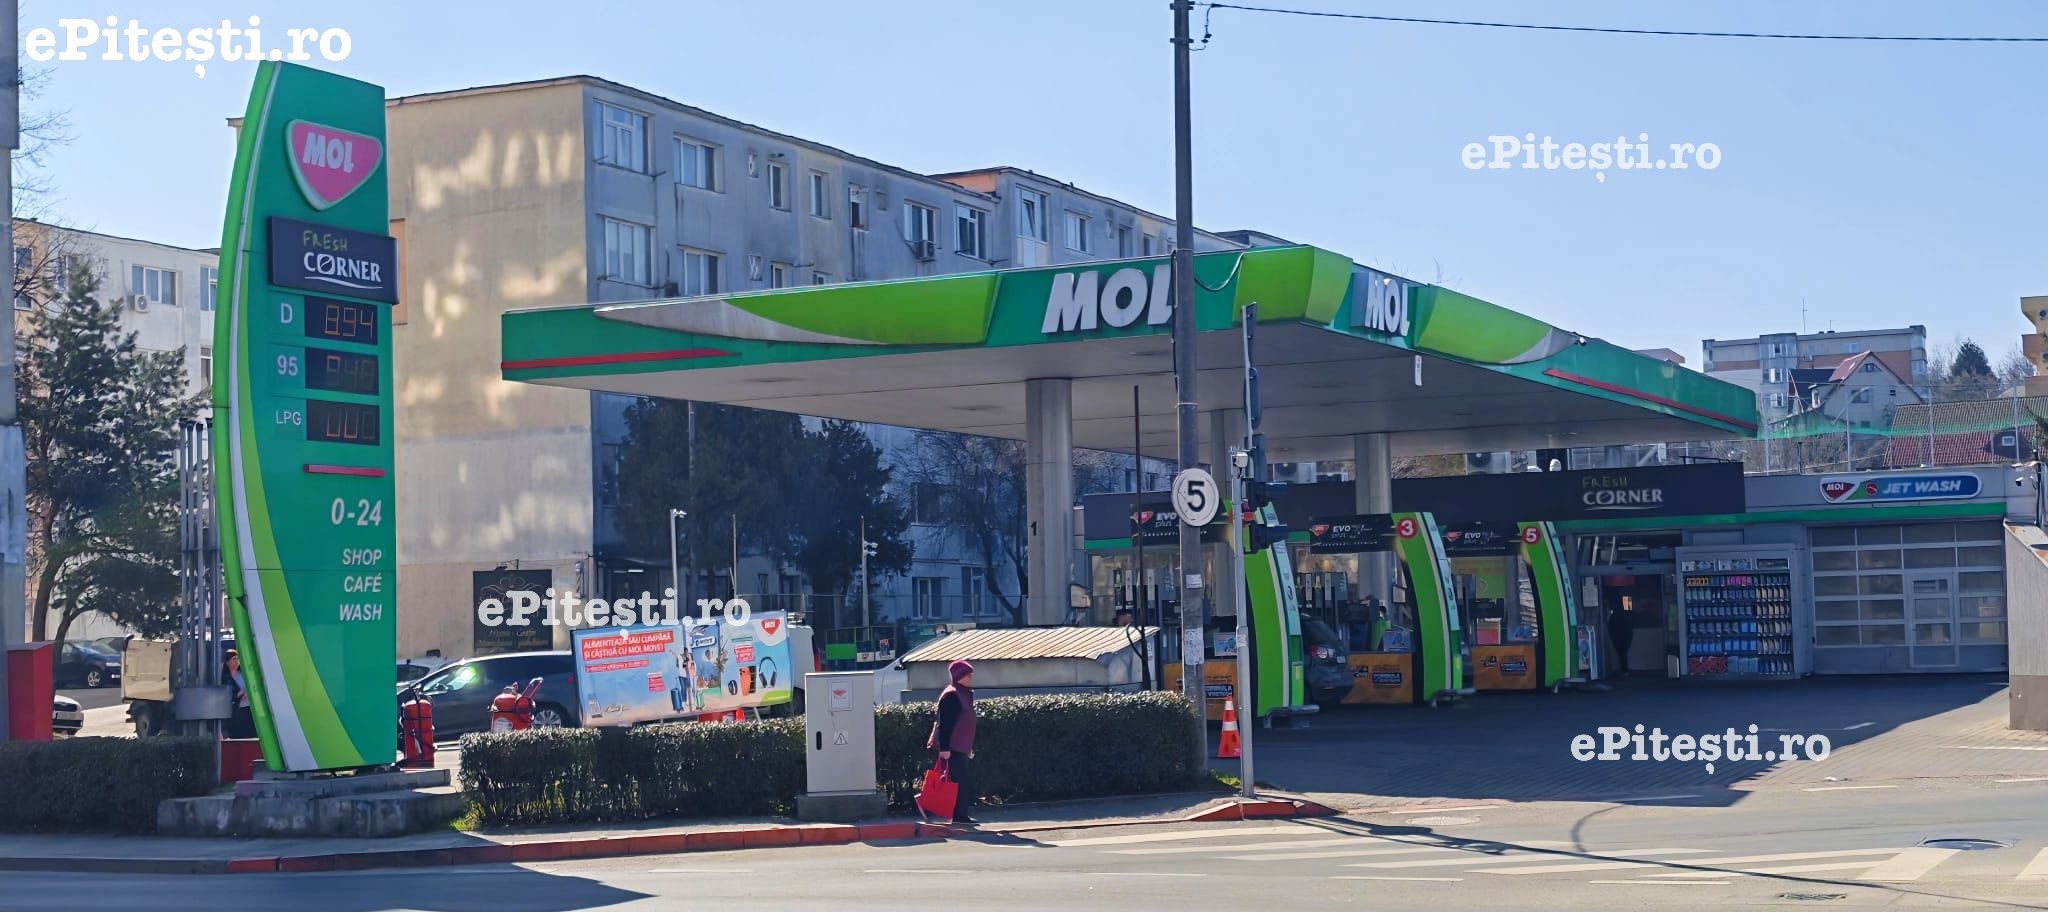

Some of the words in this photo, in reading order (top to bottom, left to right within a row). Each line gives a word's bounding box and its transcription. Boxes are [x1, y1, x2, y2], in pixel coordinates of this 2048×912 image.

[303, 132, 354, 173] MOL
[303, 230, 348, 251] FRESH
[303, 252, 382, 283] CORNER
[1041, 264, 1173, 334] MOL
[1364, 276, 1411, 337] MOL
[280, 303, 293, 325] D
[276, 355, 299, 377] 95
[275, 410, 302, 427] LPG
[1582, 476, 1628, 488] FRESH
[1883, 482, 1910, 494] JET
[1915, 480, 1962, 492] WASH
[1188, 481, 1206, 512] 5
[1583, 489, 1663, 505] CORNER
[331, 498, 382, 527] 0-24
[1333, 525, 1351, 533] EVO
[1400, 519, 1414, 536] 3
[1526, 528, 1537, 542] 5
[342, 548, 382, 567] SHOP
[344, 573, 382, 593] CAFÉ
[339, 604, 382, 622] WASH
